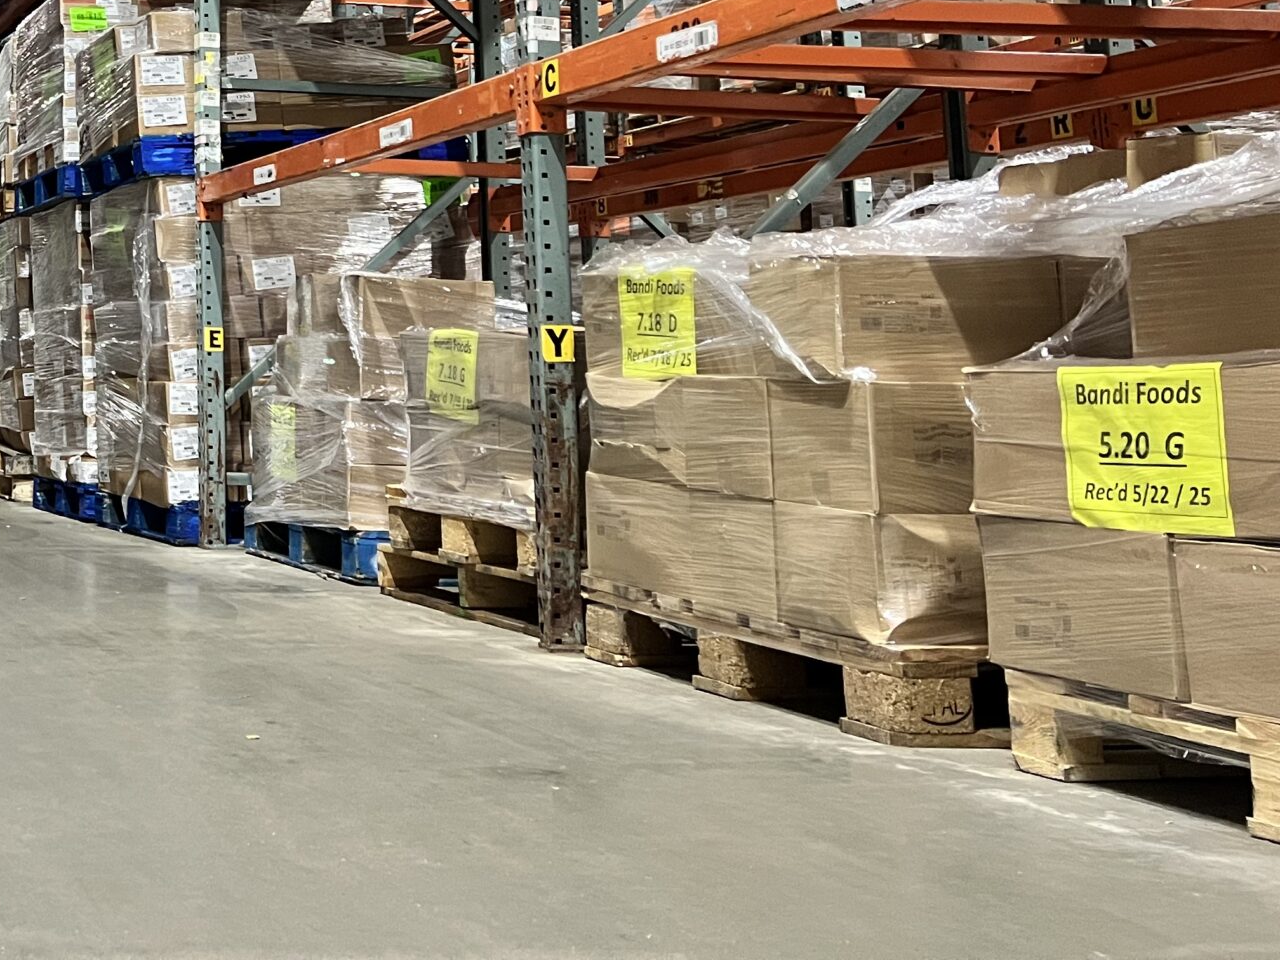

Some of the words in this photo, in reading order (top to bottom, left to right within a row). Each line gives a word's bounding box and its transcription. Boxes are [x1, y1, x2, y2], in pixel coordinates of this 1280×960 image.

[544, 63, 557, 93] C
[1135, 97, 1153, 121] U
[626, 278, 654, 294] Bandi
[656, 279, 686, 296] Foods
[637, 312, 662, 332] 7.18
[668, 313, 678, 333] D
[209, 330, 221, 348] E
[545, 328, 568, 358] Y
[438, 362, 457, 381] 7.18
[459, 367, 466, 383] G
[680, 353, 692, 368] 25
[1075, 381, 1129, 406] Bandi
[1136, 379, 1202, 405] Foods
[1098, 431, 1150, 460] 5.20
[1165, 431, 1185, 460] G
[1084, 482, 1128, 502] Rec'd
[1133, 482, 1170, 507] 5/22
[1173, 483, 1184, 509] /
[1189, 486, 1212, 507] 25
